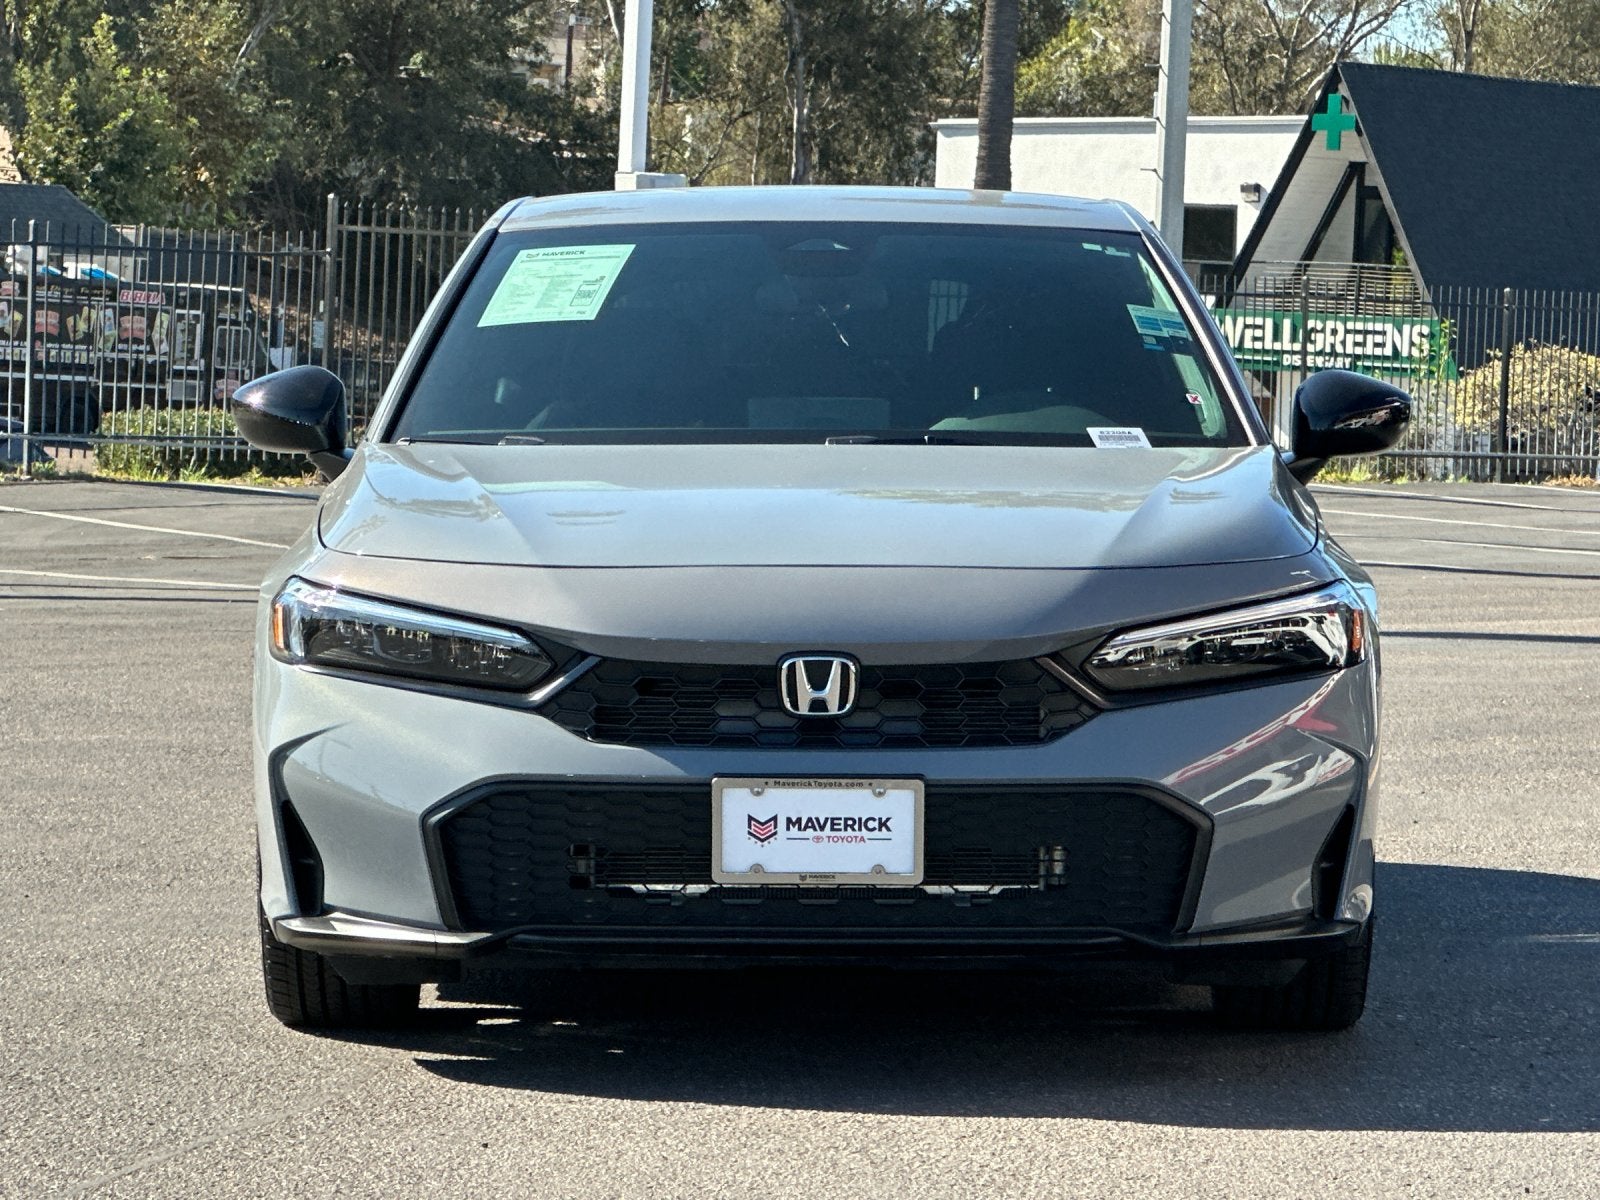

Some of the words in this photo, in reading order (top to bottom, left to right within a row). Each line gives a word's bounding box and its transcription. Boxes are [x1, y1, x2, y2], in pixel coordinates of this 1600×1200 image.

[120, 289, 166, 305] BRRIA
[1215, 314, 1430, 357] WELLGREENS
[1282, 354, 1352, 368] DISENARY
[773, 780, 864, 788] MaverickToyota.com
[785, 816, 892, 832] MAVERICK
[827, 835, 866, 843] TOYOTA
